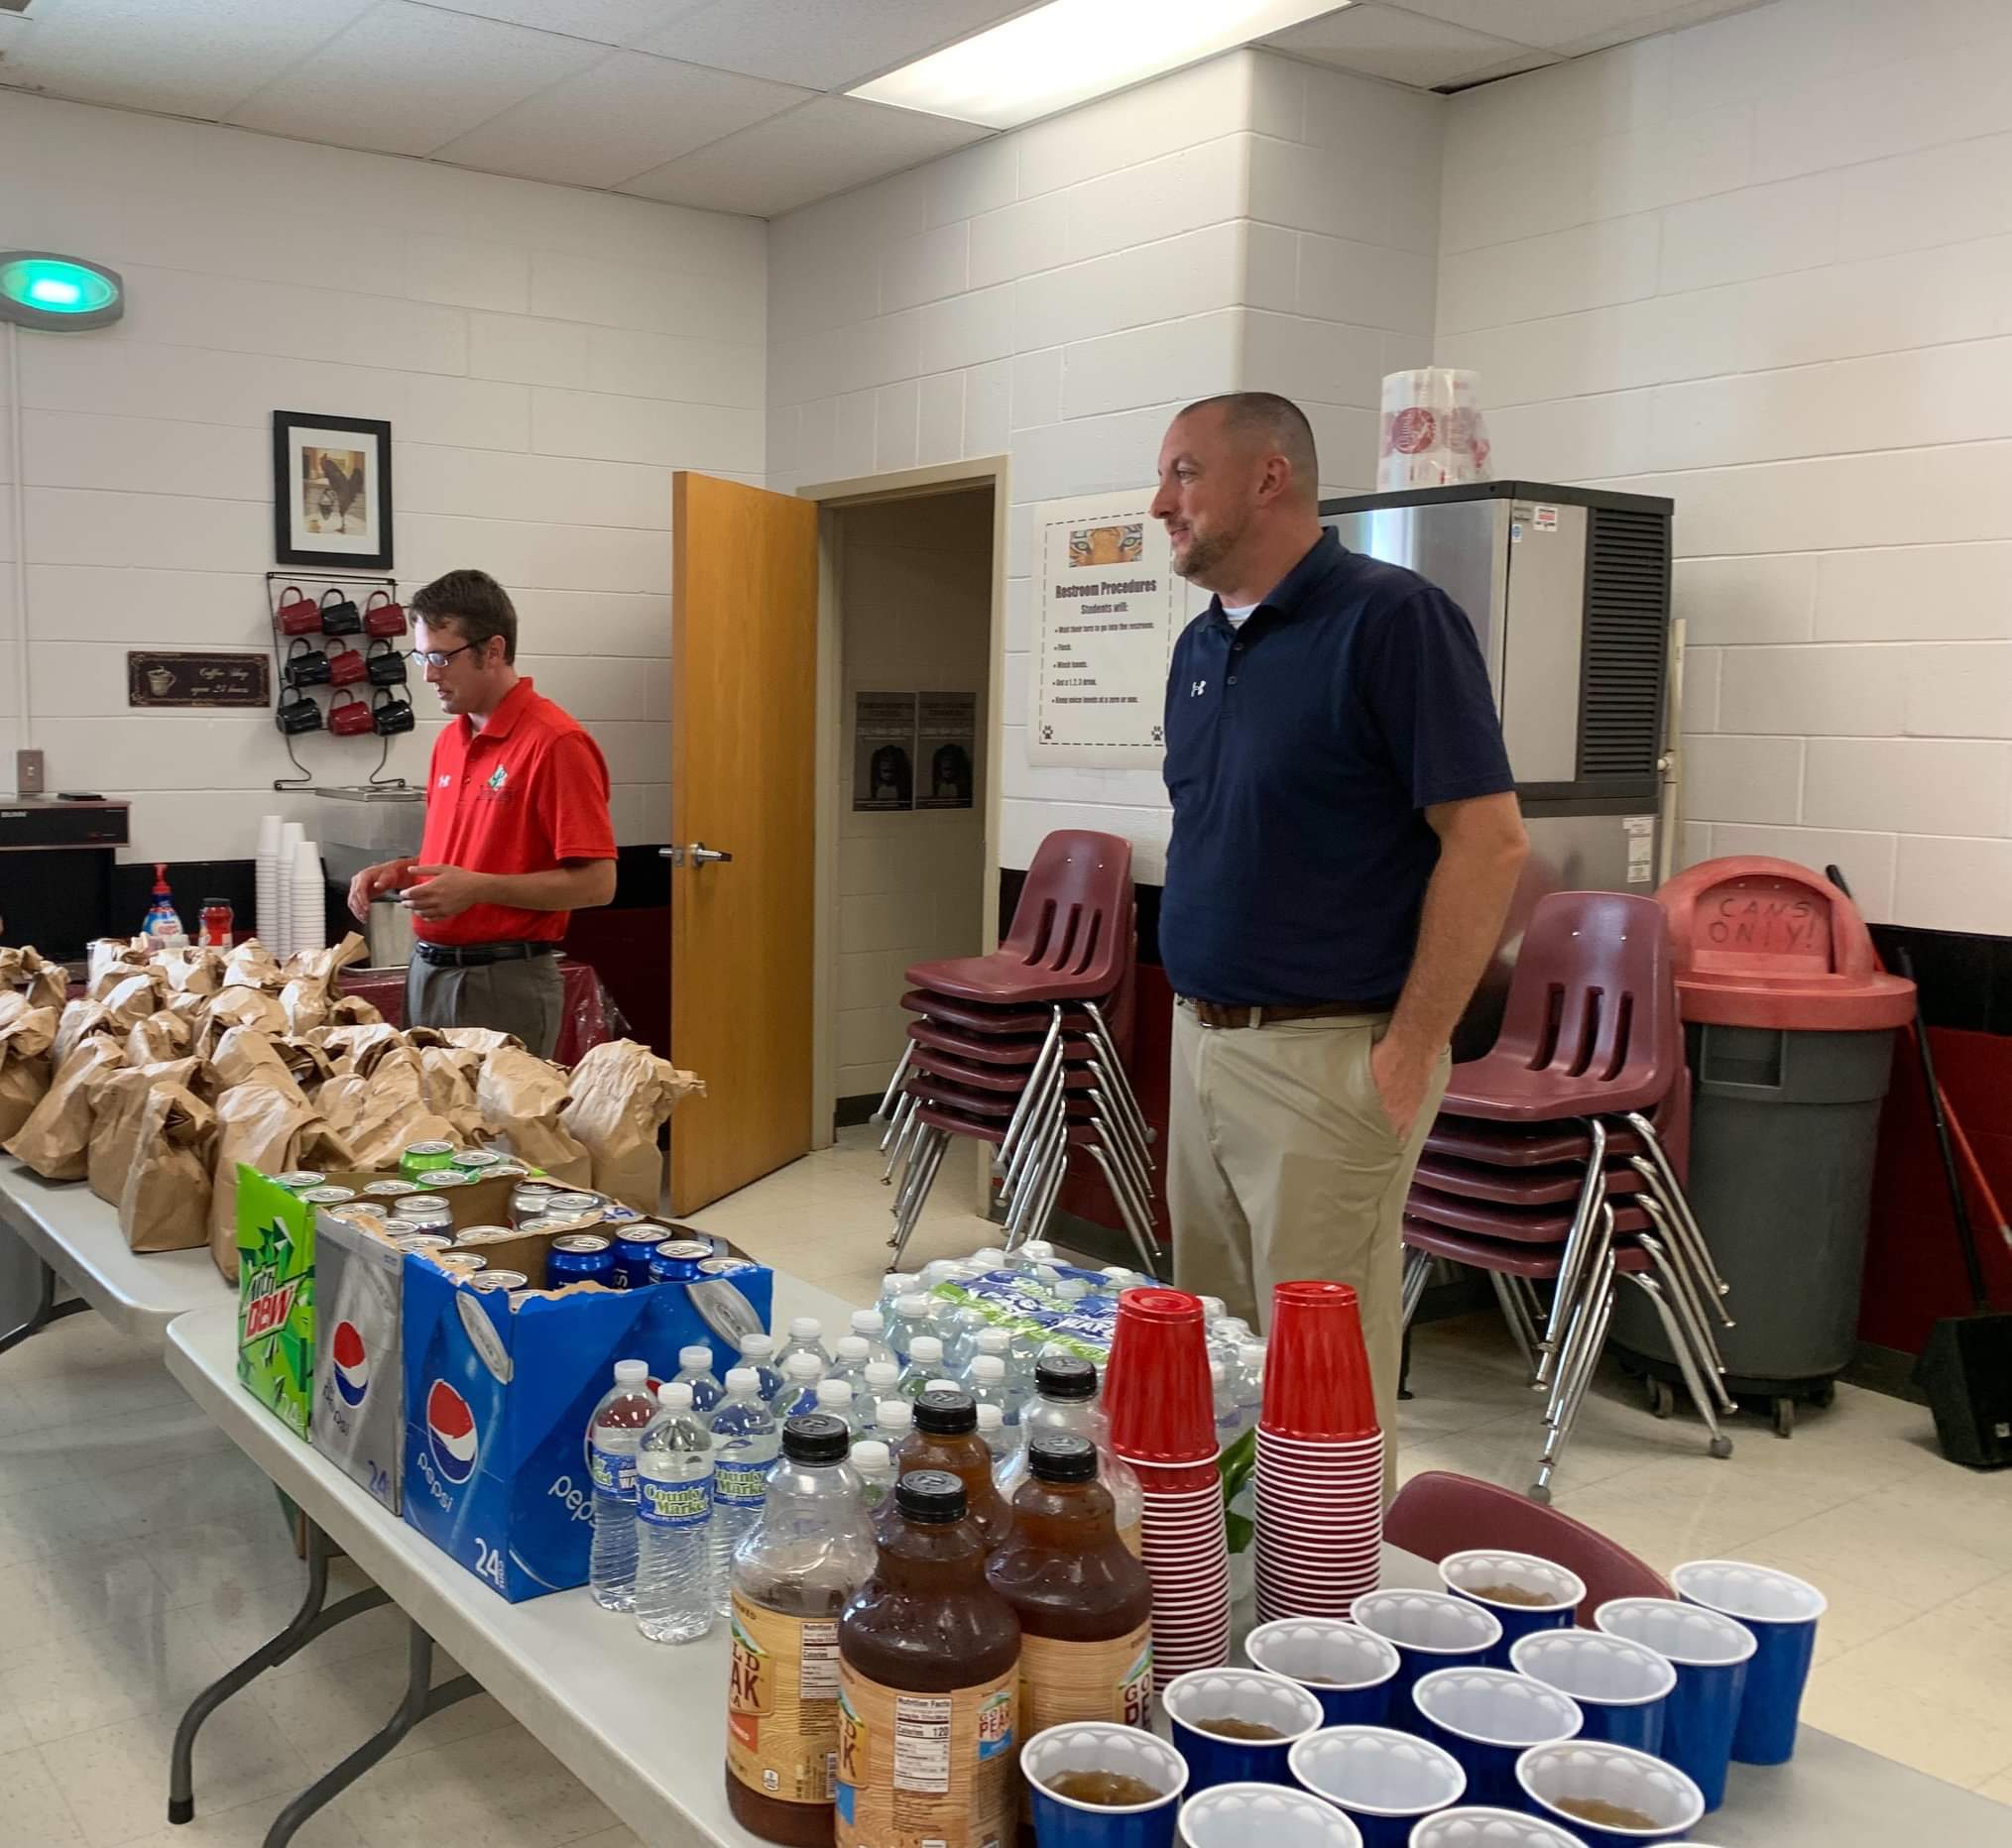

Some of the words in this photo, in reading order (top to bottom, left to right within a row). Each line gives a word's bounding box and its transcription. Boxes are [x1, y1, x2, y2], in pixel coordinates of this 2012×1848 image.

[1055, 585, 1099, 599] Restroom
[1100, 579, 1157, 596] Procedures
[1081, 604, 1112, 615] Students
[1720, 897, 1810, 919] CANS
[417, 1452, 453, 1513] pepsi
[714, 1468, 768, 1484] ounty
[644, 1483, 705, 1501] County
[717, 1477, 763, 1497] Marke
[547, 1475, 597, 1529] pep
[475, 1538, 500, 1586] 24
